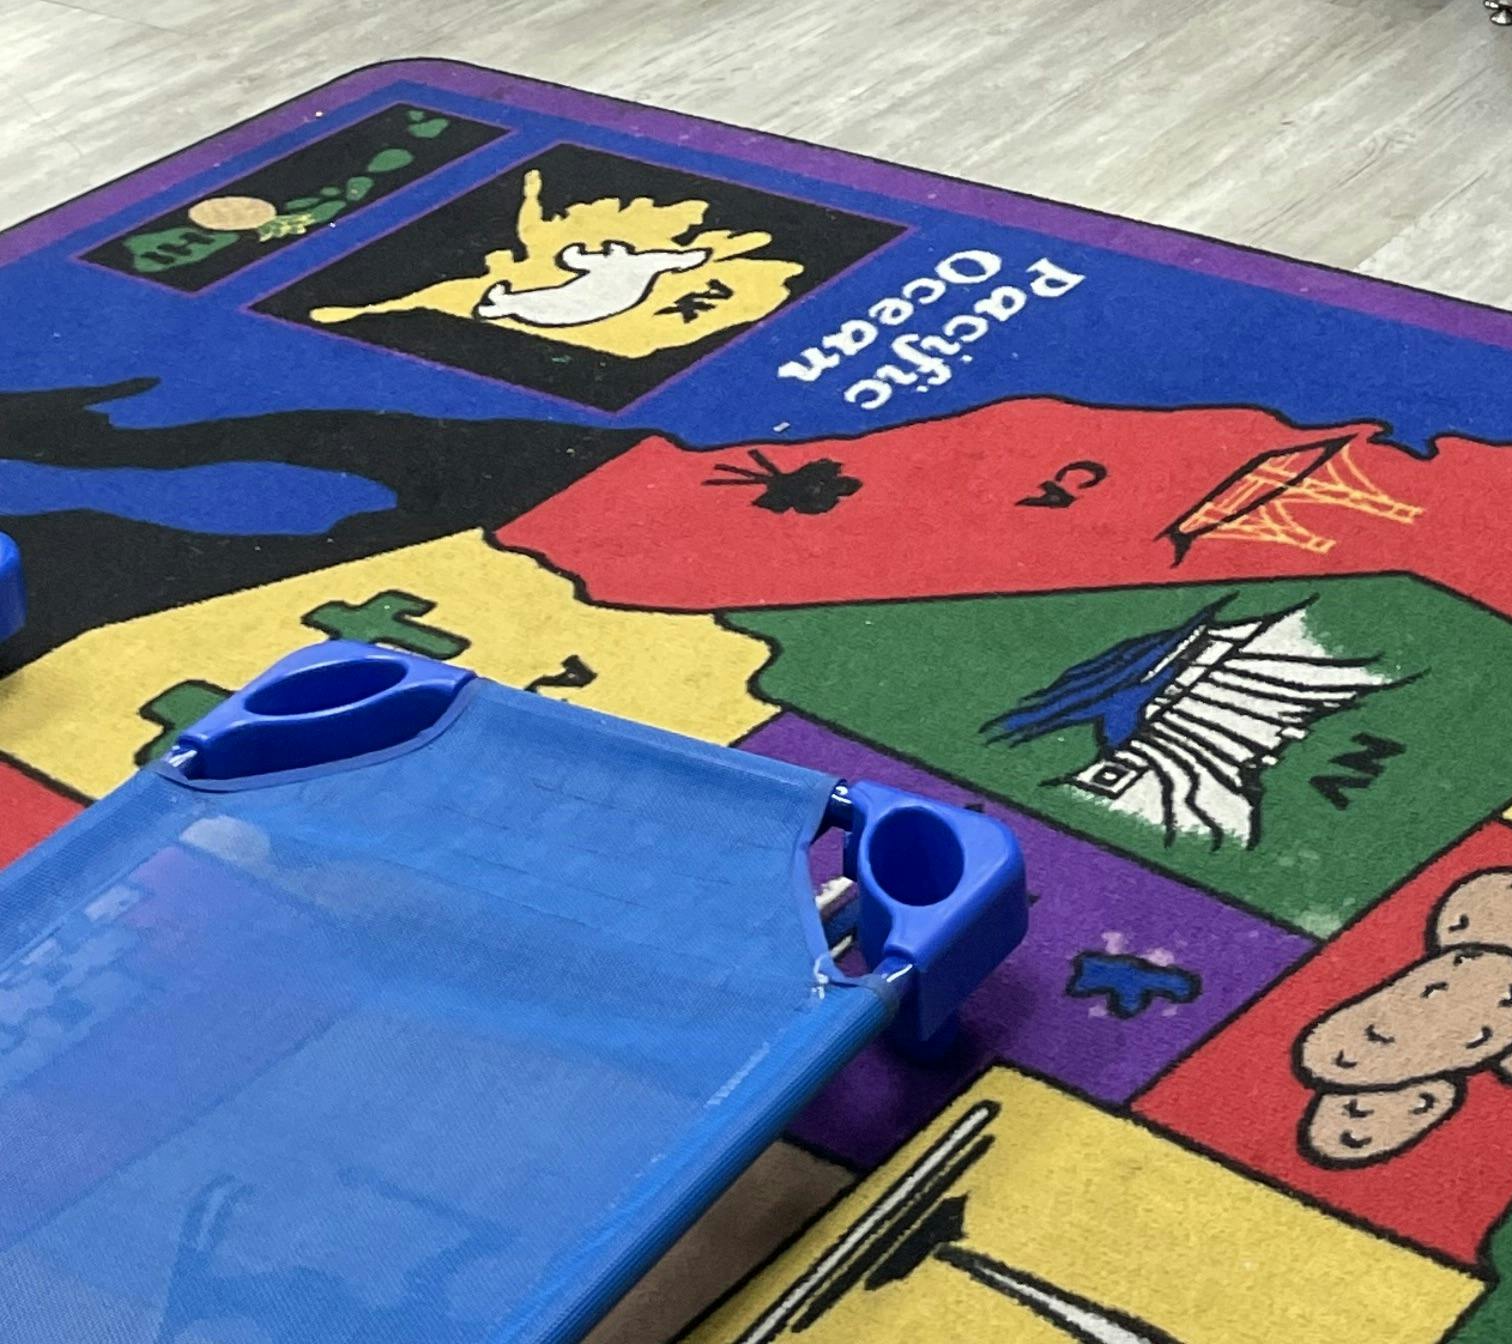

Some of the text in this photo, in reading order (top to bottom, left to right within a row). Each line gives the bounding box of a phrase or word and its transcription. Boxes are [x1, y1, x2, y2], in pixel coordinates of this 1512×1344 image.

[653, 279, 735, 324] AK
[778, 250, 1001, 382] Ocean
[844, 258, 1086, 410] Pacific
[1015, 461, 1108, 509] CA
[1307, 732, 1408, 811] NV
